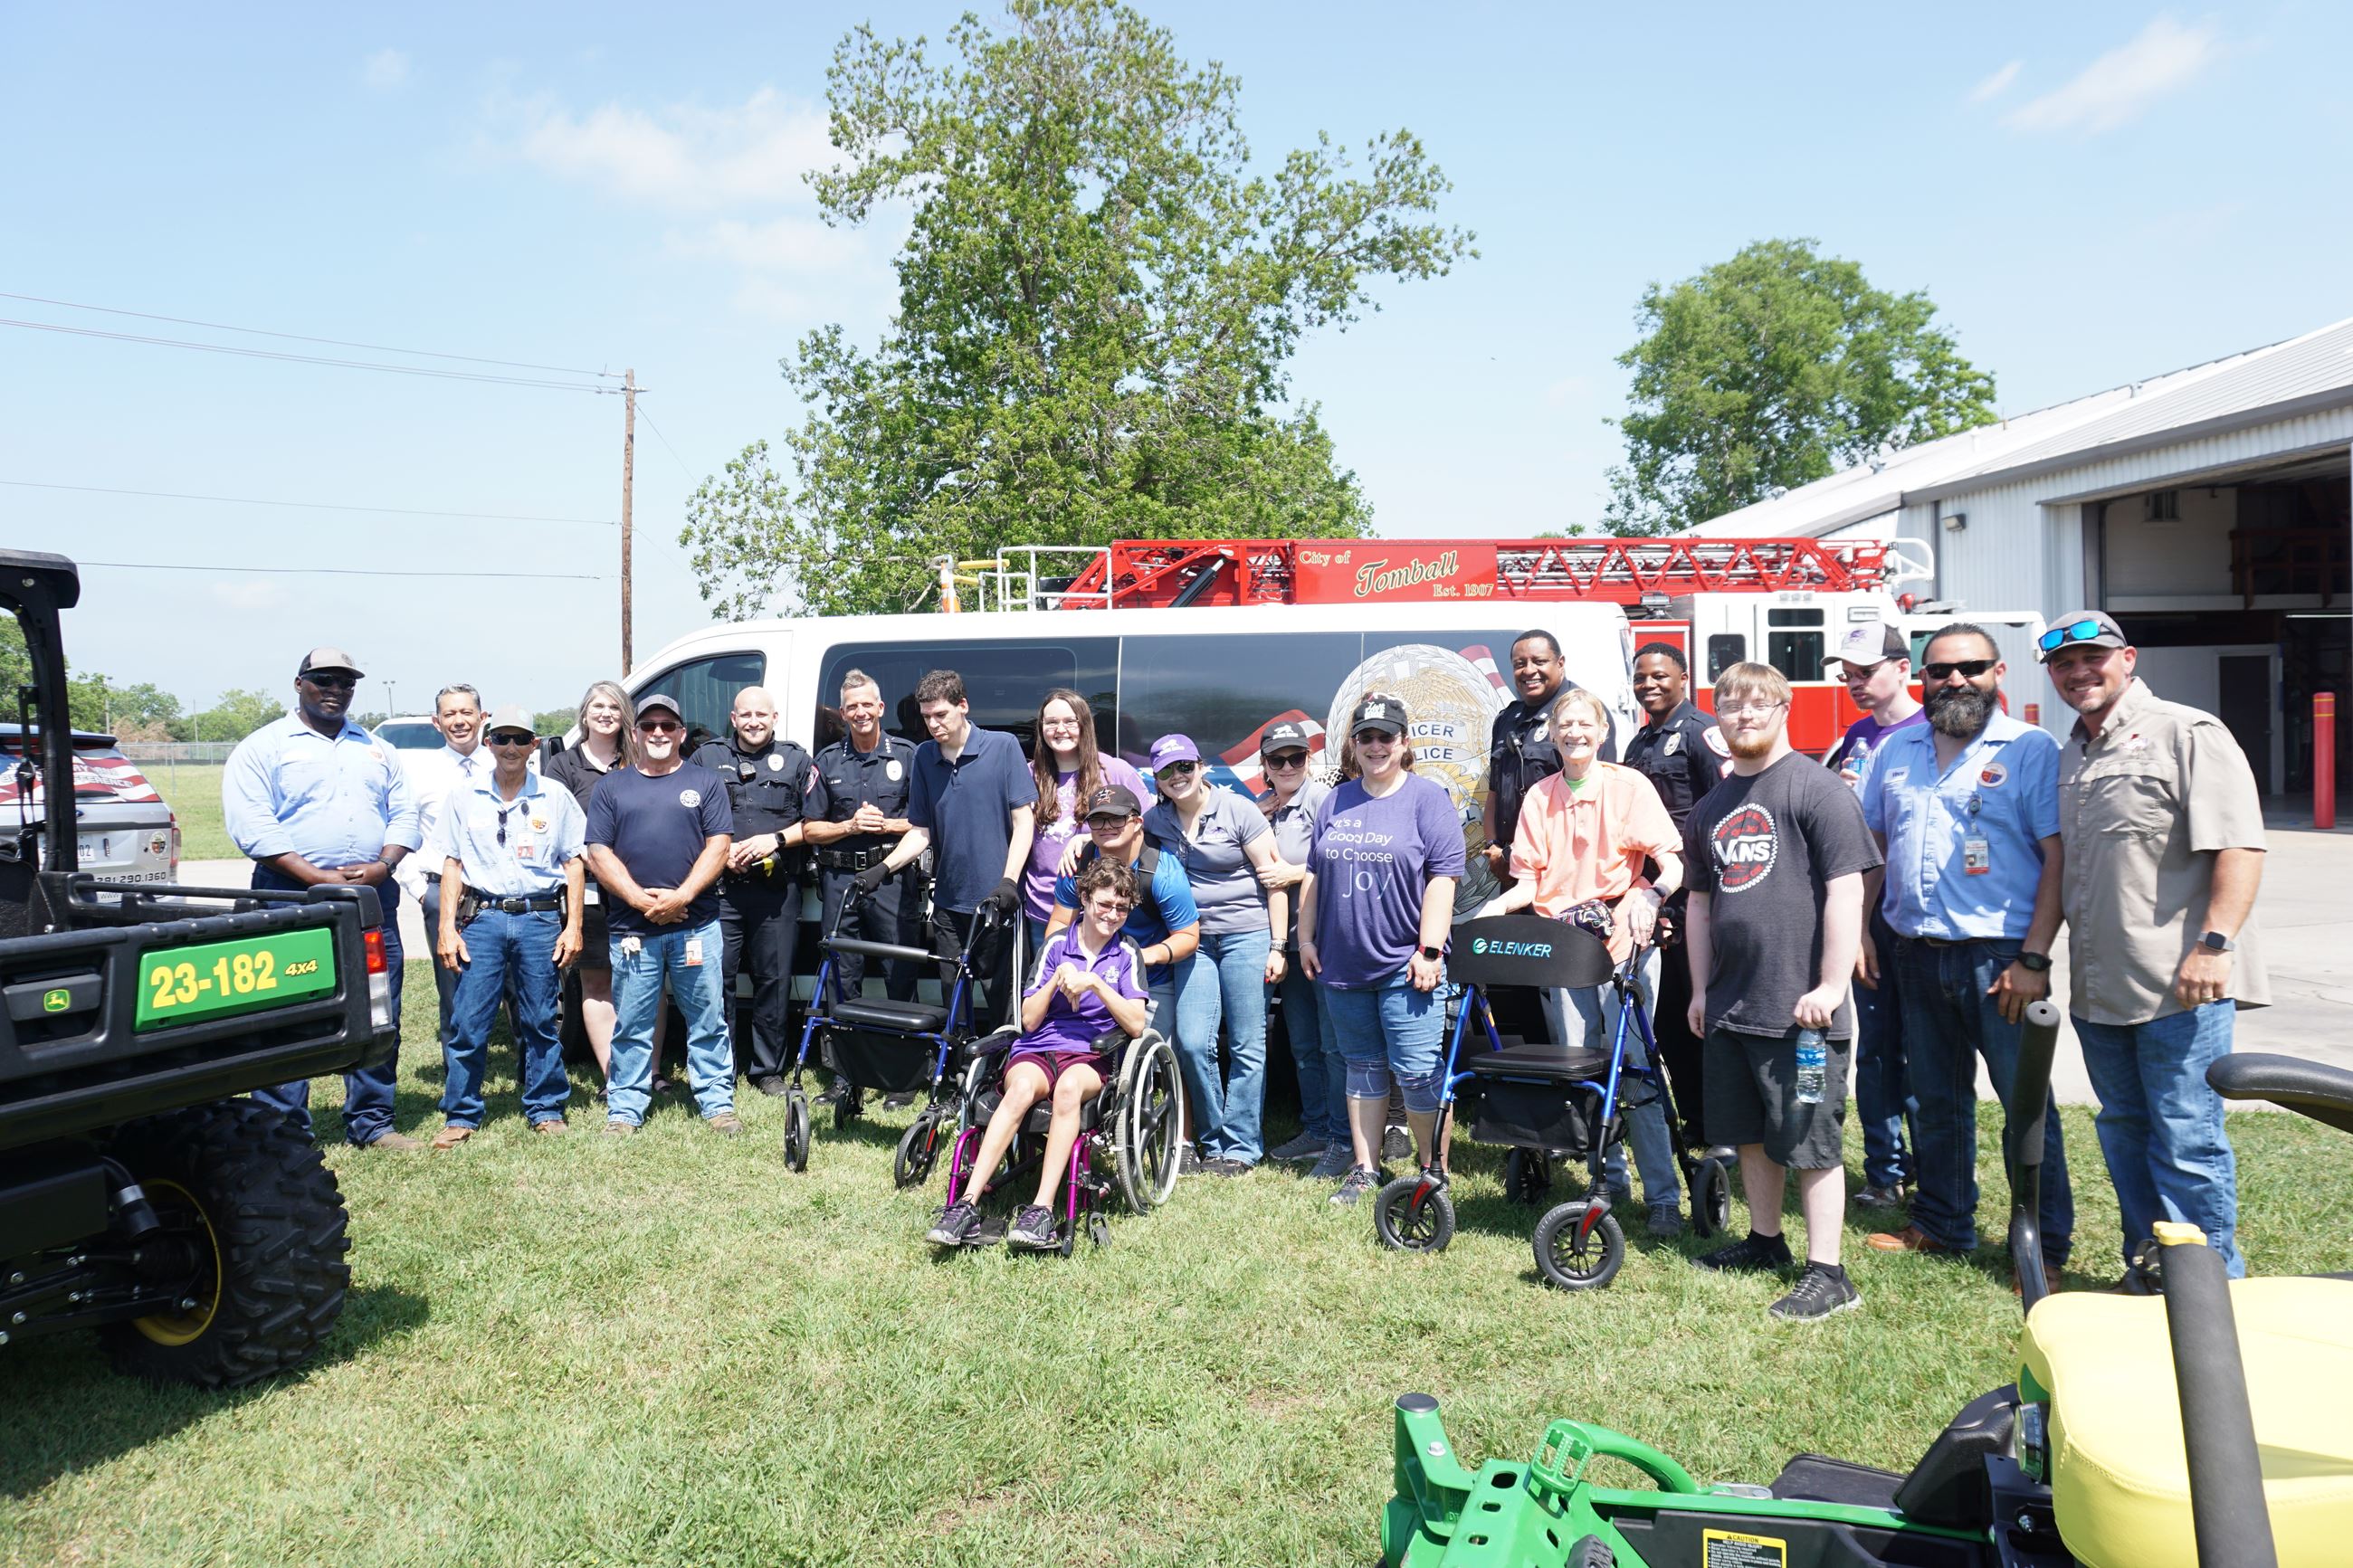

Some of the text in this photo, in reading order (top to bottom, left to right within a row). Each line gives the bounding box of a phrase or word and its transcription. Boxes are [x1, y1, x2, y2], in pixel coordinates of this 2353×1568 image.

[1300, 550, 1351, 566] City of
[1354, 550, 1460, 597] Tomball
[1433, 584, 1494, 597] Est. 1907
[1412, 724, 1454, 737] ICER
[1414, 747, 1453, 761] LICE
[1333, 817, 1362, 828] It's a
[1328, 832, 1394, 846] Good Day
[1325, 848, 1394, 862] to Choose
[1714, 834, 1773, 866] VANS
[1489, 940, 1552, 958] ELENKER
[150, 950, 278, 1009] 23-182
[1732, 1535, 1759, 1544] CAUTION
